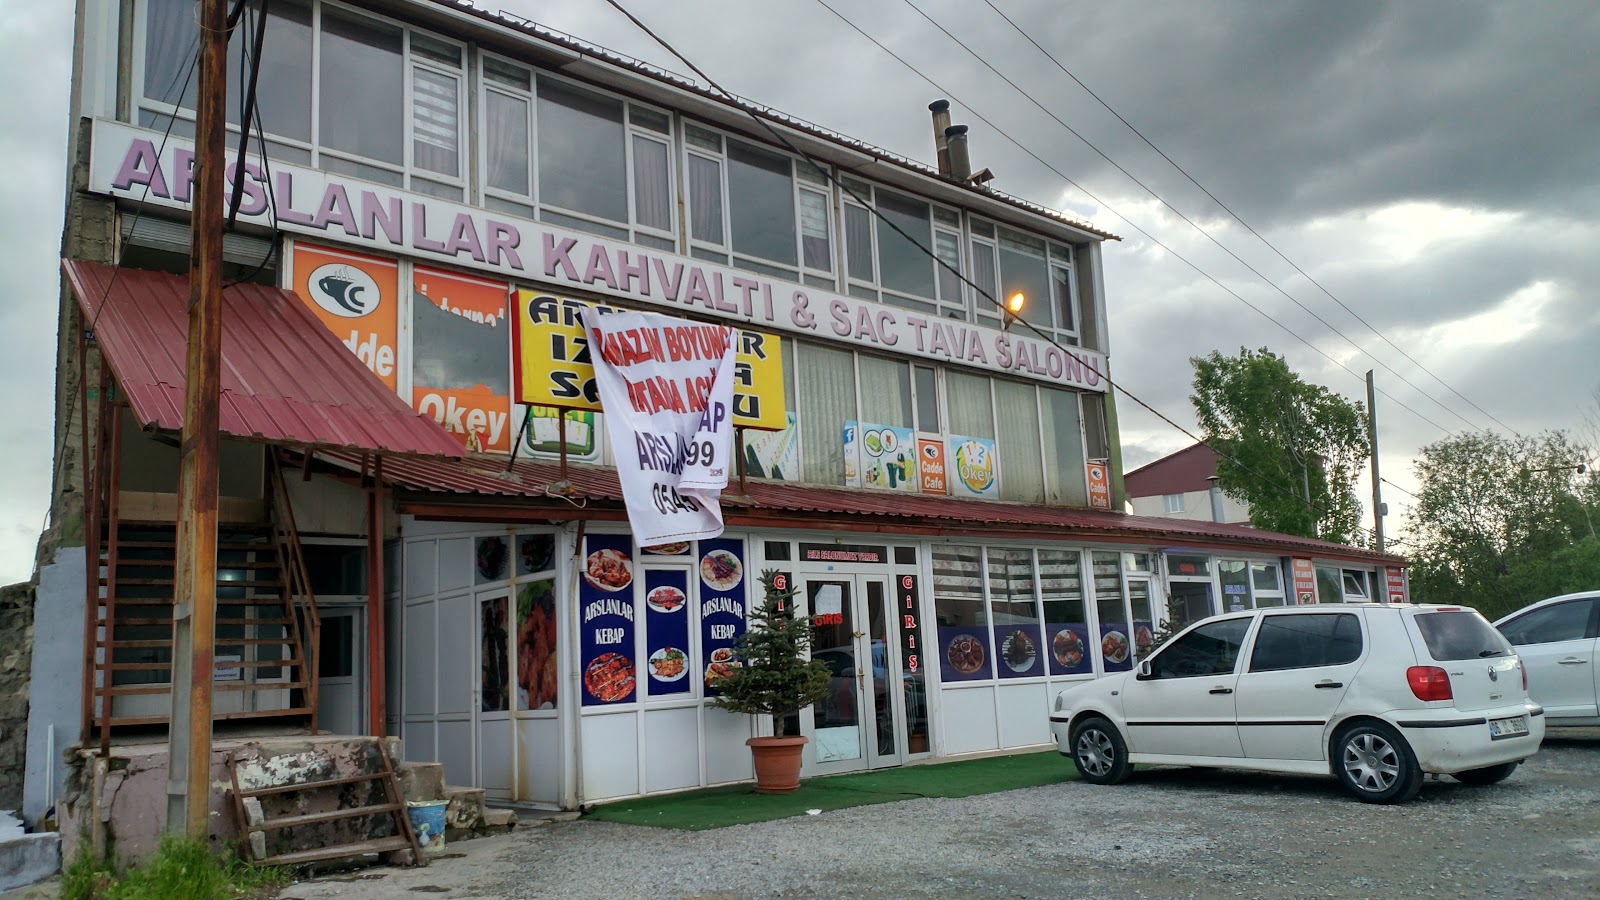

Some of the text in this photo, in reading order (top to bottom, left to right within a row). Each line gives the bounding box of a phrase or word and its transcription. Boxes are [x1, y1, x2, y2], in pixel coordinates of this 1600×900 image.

[542, 231, 774, 323] KAHVALTI
[790, 290, 817, 330] &
[907, 316, 988, 364] TAVA
[994, 335, 1100, 387] SALONU
[419, 393, 507, 445] Okey
[922, 460, 943, 475] Cadde
[960, 464, 992, 482] Okey
[924, 475, 943, 489] Cafe
[1090, 482, 1107, 494] Cadde
[1093, 495, 1107, 507] Cafe
[584, 598, 634, 624] ARSLANLAR
[702, 597, 743, 621] ARSLANLAR
[595, 627, 625, 645] KEBAP
[711, 624, 736, 640] KEBAP
